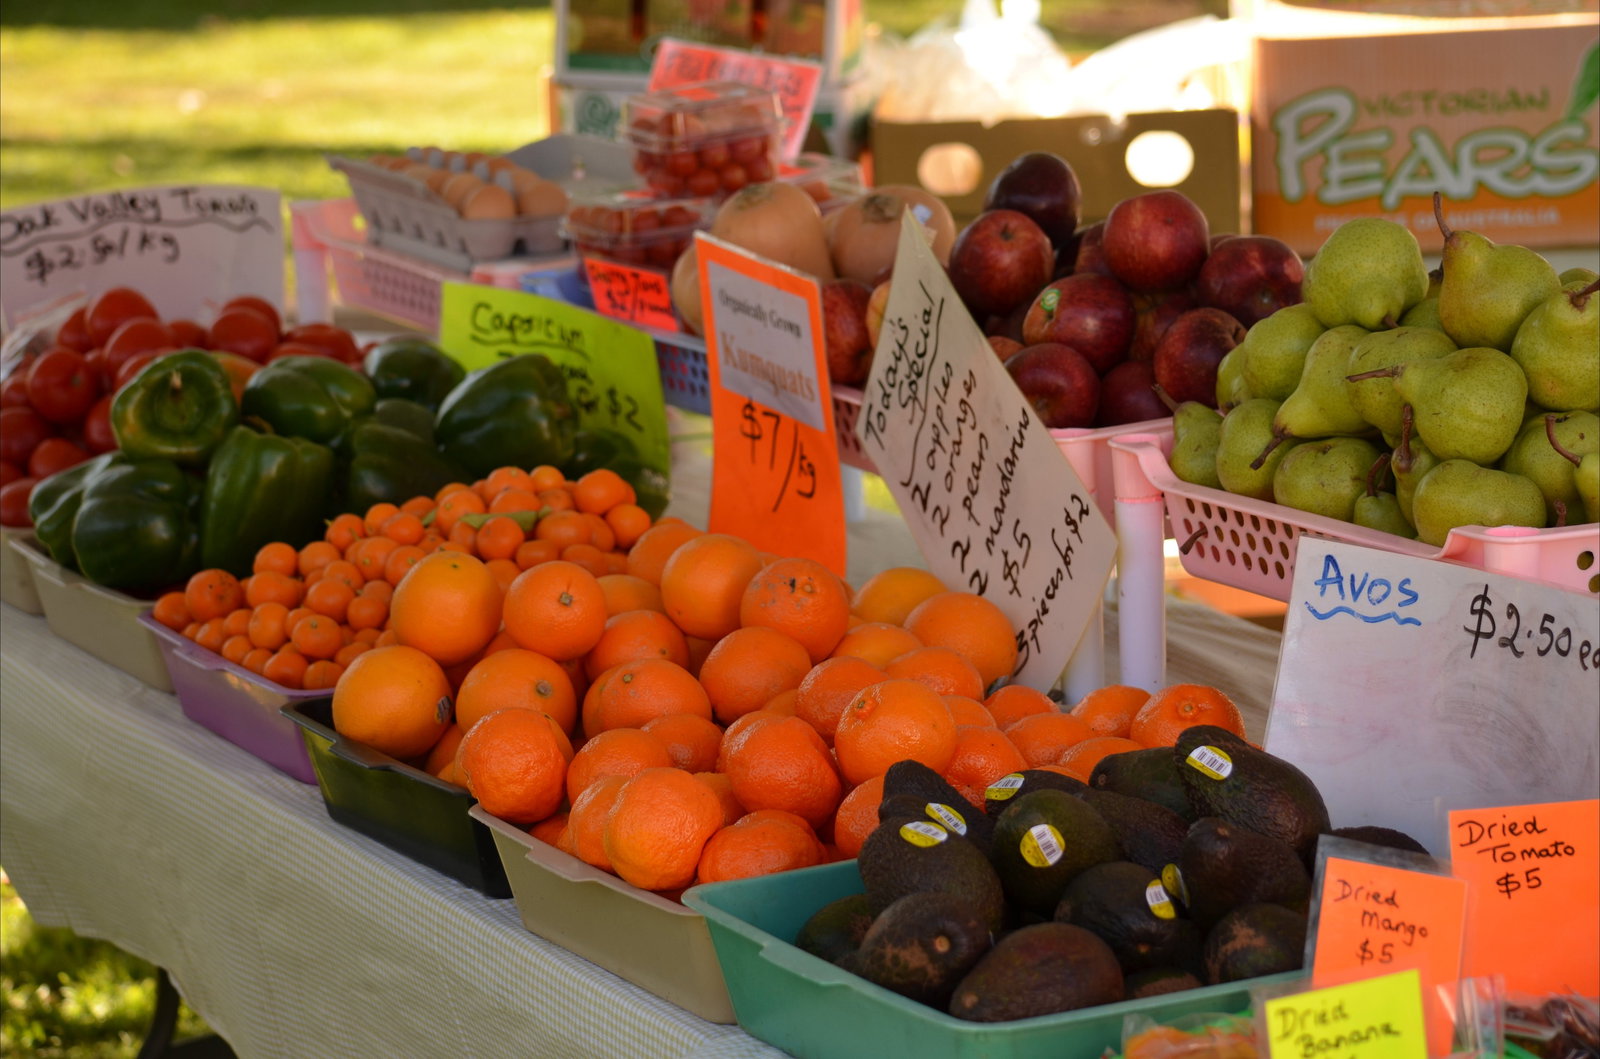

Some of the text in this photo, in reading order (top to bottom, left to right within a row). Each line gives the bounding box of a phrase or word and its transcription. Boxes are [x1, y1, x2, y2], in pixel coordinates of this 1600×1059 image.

[1361, 87, 1550, 118] VICTORIAN
[1274, 87, 1599, 210] PEARS
[66, 190, 163, 222] Valley
[470, 301, 586, 346] Capsicum
[718, 287, 768, 329] Organically
[768, 308, 802, 339] Grown
[719, 331, 816, 403] Kumquats
[898, 279, 936, 425] Special
[864, 316, 912, 450] Today's
[606, 386, 645, 433] $2
[911, 361, 954, 513] 2 apples
[931, 368, 977, 538] 2 oranges
[951, 432, 989, 574] 2 pears
[1002, 518, 1032, 599] $5
[1050, 527, 1075, 581] for
[1063, 493, 1091, 545] $2
[968, 568, 989, 597] 2
[1314, 553, 1420, 607] Avos
[1463, 583, 1573, 659] $2.50
[1457, 814, 1549, 848] Dried
[1476, 841, 1576, 864] Tomato
[1333, 879, 1400, 910] Dried
[1495, 867, 1543, 901] $5
[1355, 938, 1395, 967] $5
[1273, 998, 1351, 1043] Dried
[1293, 1021, 1403, 1059] Banana
